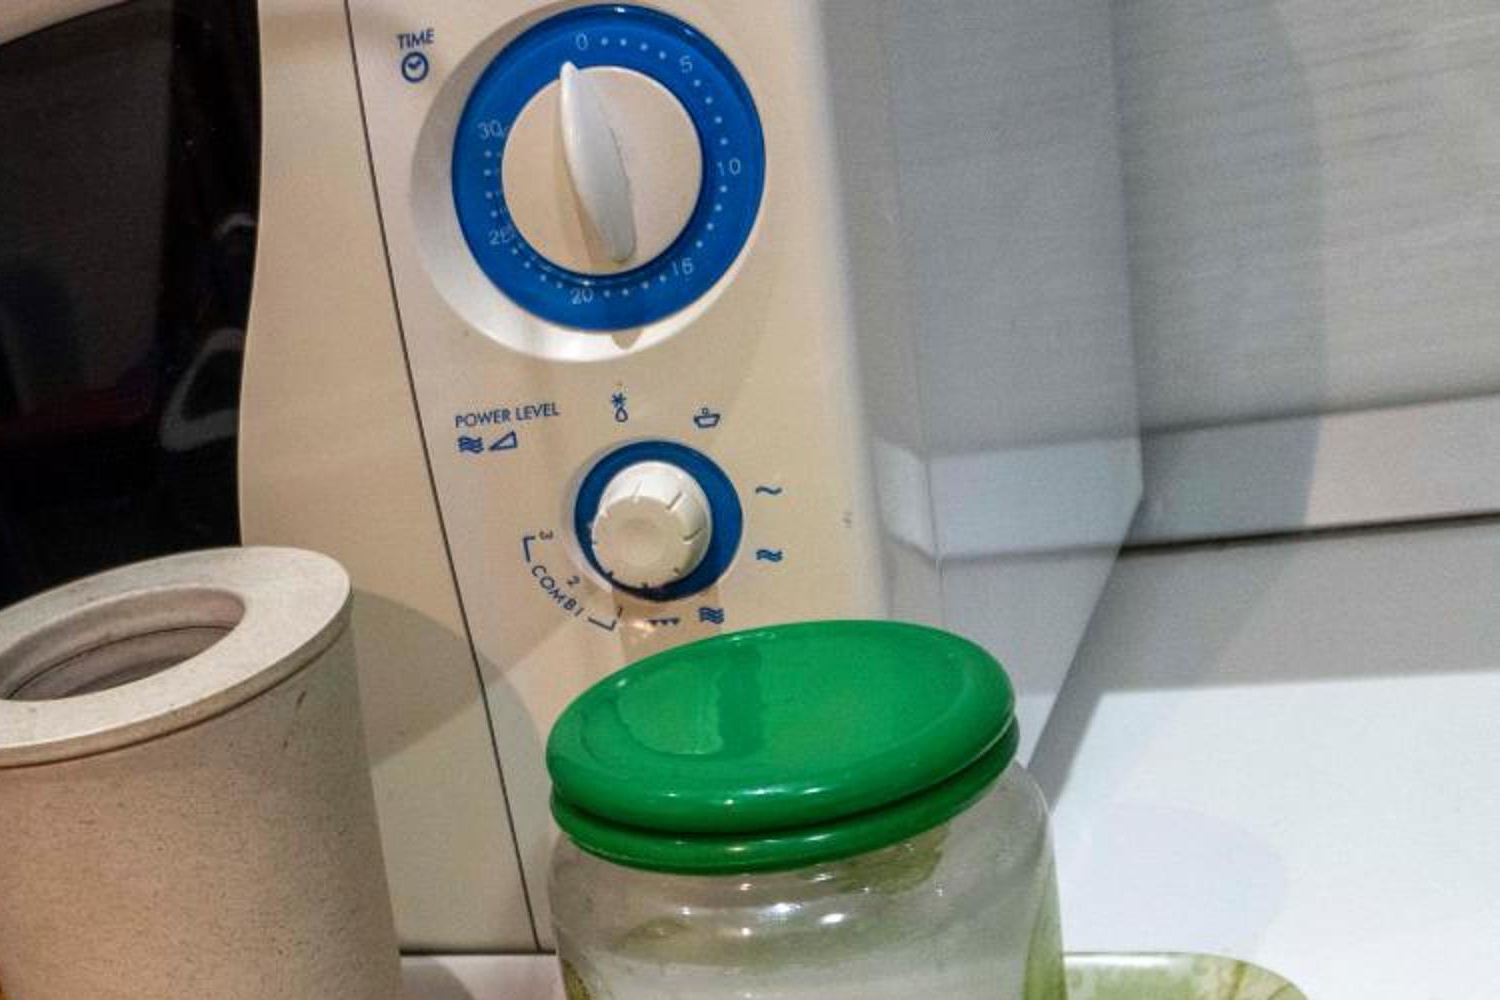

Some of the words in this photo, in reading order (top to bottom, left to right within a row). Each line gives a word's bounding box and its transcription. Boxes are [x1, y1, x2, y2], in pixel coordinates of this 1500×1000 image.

[396, 27, 435, 49] TIME
[574, 33, 590, 50] 0
[679, 55, 693, 74] 5
[477, 119, 505, 140] 30
[715, 157, 741, 177] 10
[569, 287, 595, 305] 20
[455, 408, 511, 428] POWER
[516, 402, 560, 421] LEVEL
[531, 565, 585, 617] COMBI
